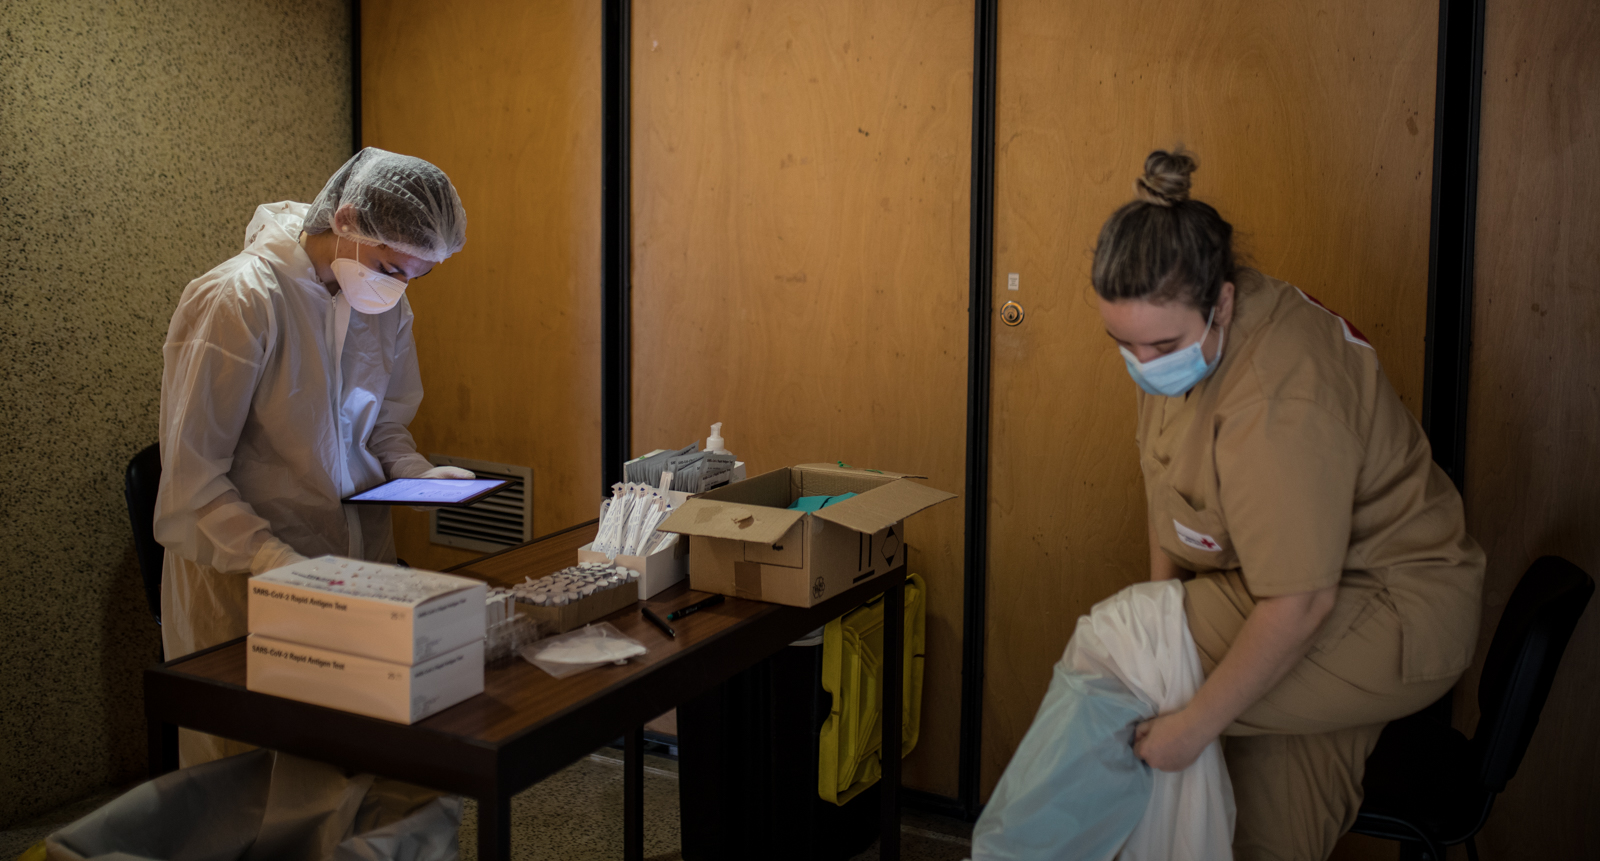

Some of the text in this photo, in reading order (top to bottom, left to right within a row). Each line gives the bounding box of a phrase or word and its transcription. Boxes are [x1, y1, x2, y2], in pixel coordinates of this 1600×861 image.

[253, 587, 347, 612] SARS-CoV-2 Rapid Antigen Test
[252, 645, 344, 670] SARS-CoV-2 Rapid Antigen Test
